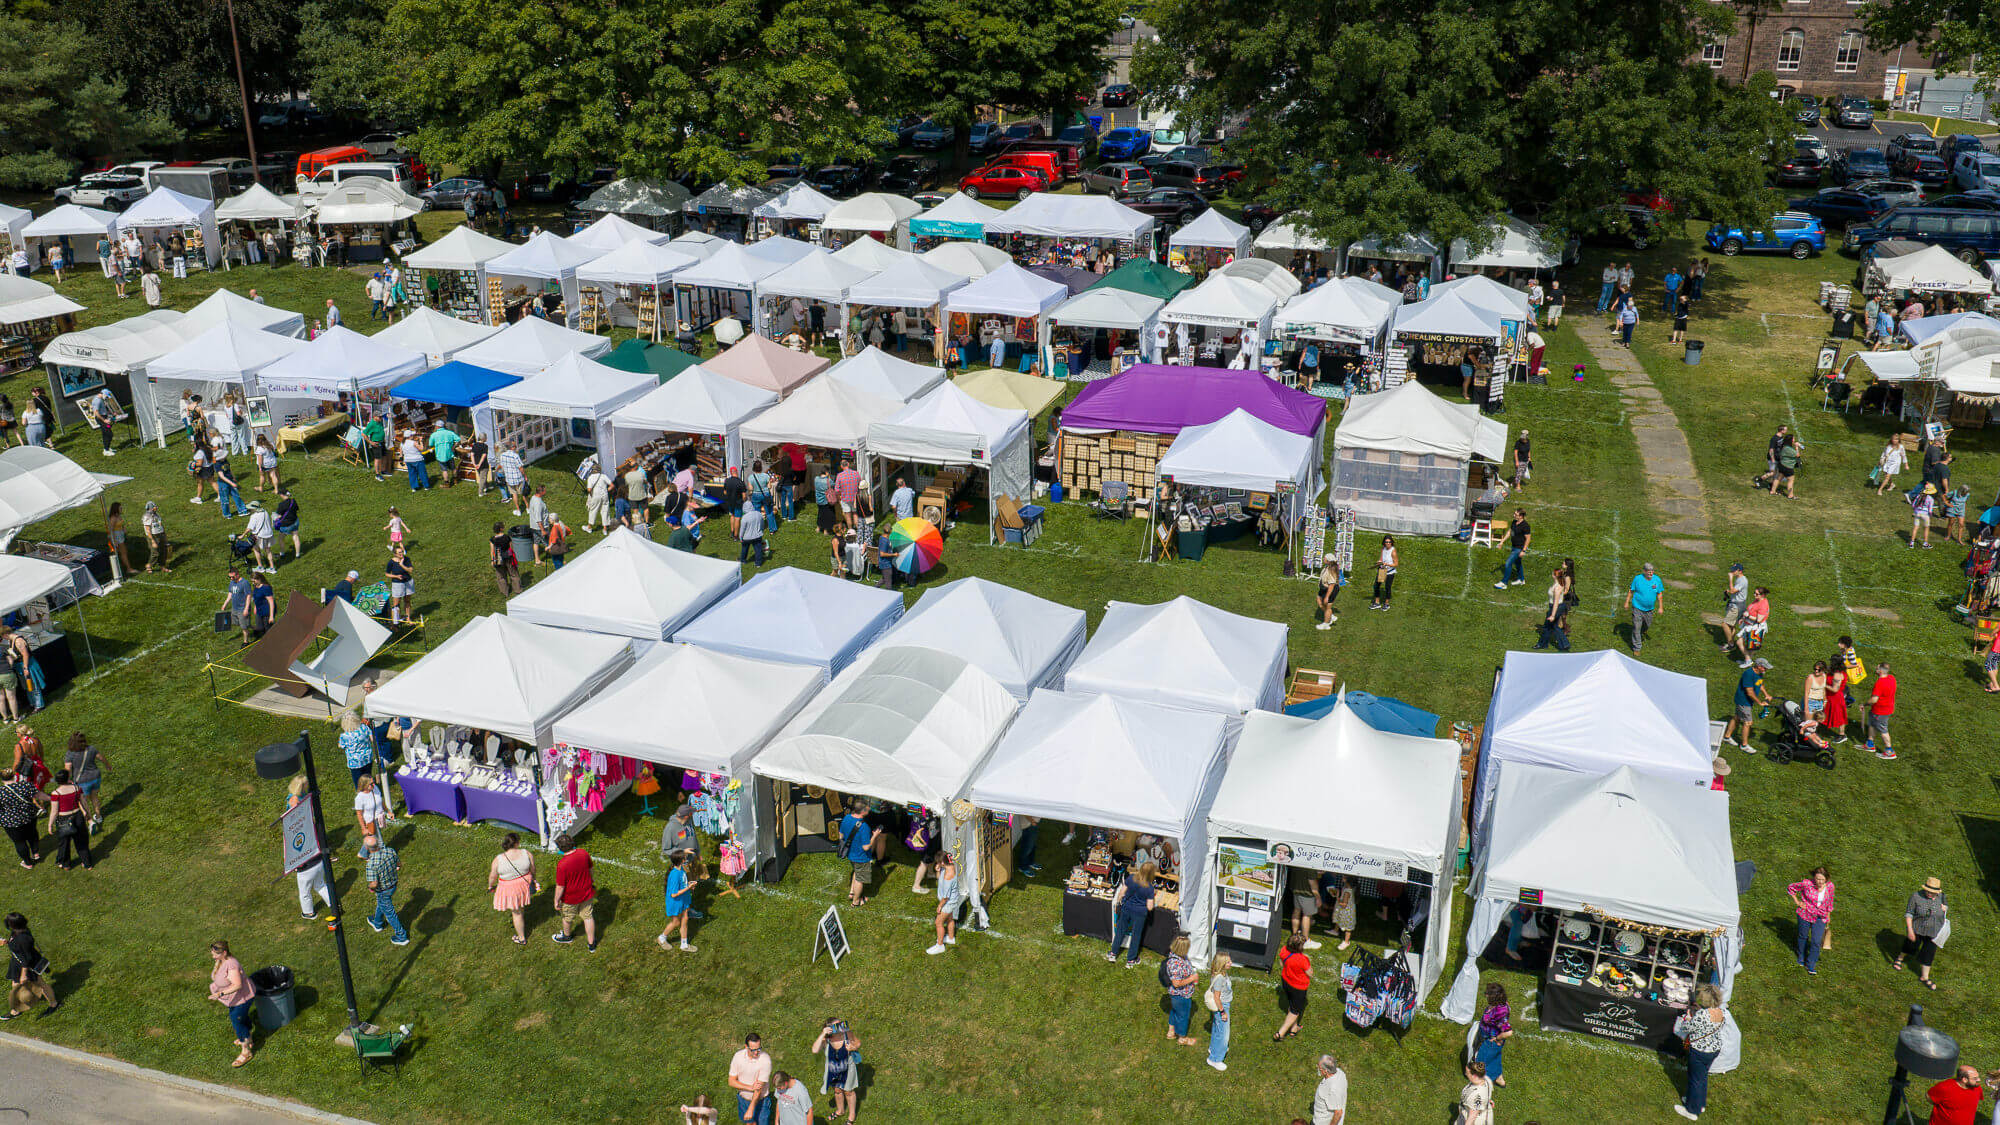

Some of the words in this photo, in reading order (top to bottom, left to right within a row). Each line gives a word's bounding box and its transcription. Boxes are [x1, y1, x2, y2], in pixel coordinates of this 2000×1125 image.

[1408, 332, 1442, 342] HEALING
[1444, 334, 1485, 344] CRYSTALS
[268, 383, 298, 393] Celluloid
[288, 847, 313, 866] ENTRANCE
[1295, 846, 1321, 861] Suzie
[1323, 850, 1352, 863] Quinn
[1352, 852, 1382, 867] Studio
[1343, 863, 1354, 872] NY
[1584, 1017, 1607, 1027] GREG
[1608, 1022, 1646, 1037] PARIZEK
[1591, 1026, 1635, 1041] CERAMICS
